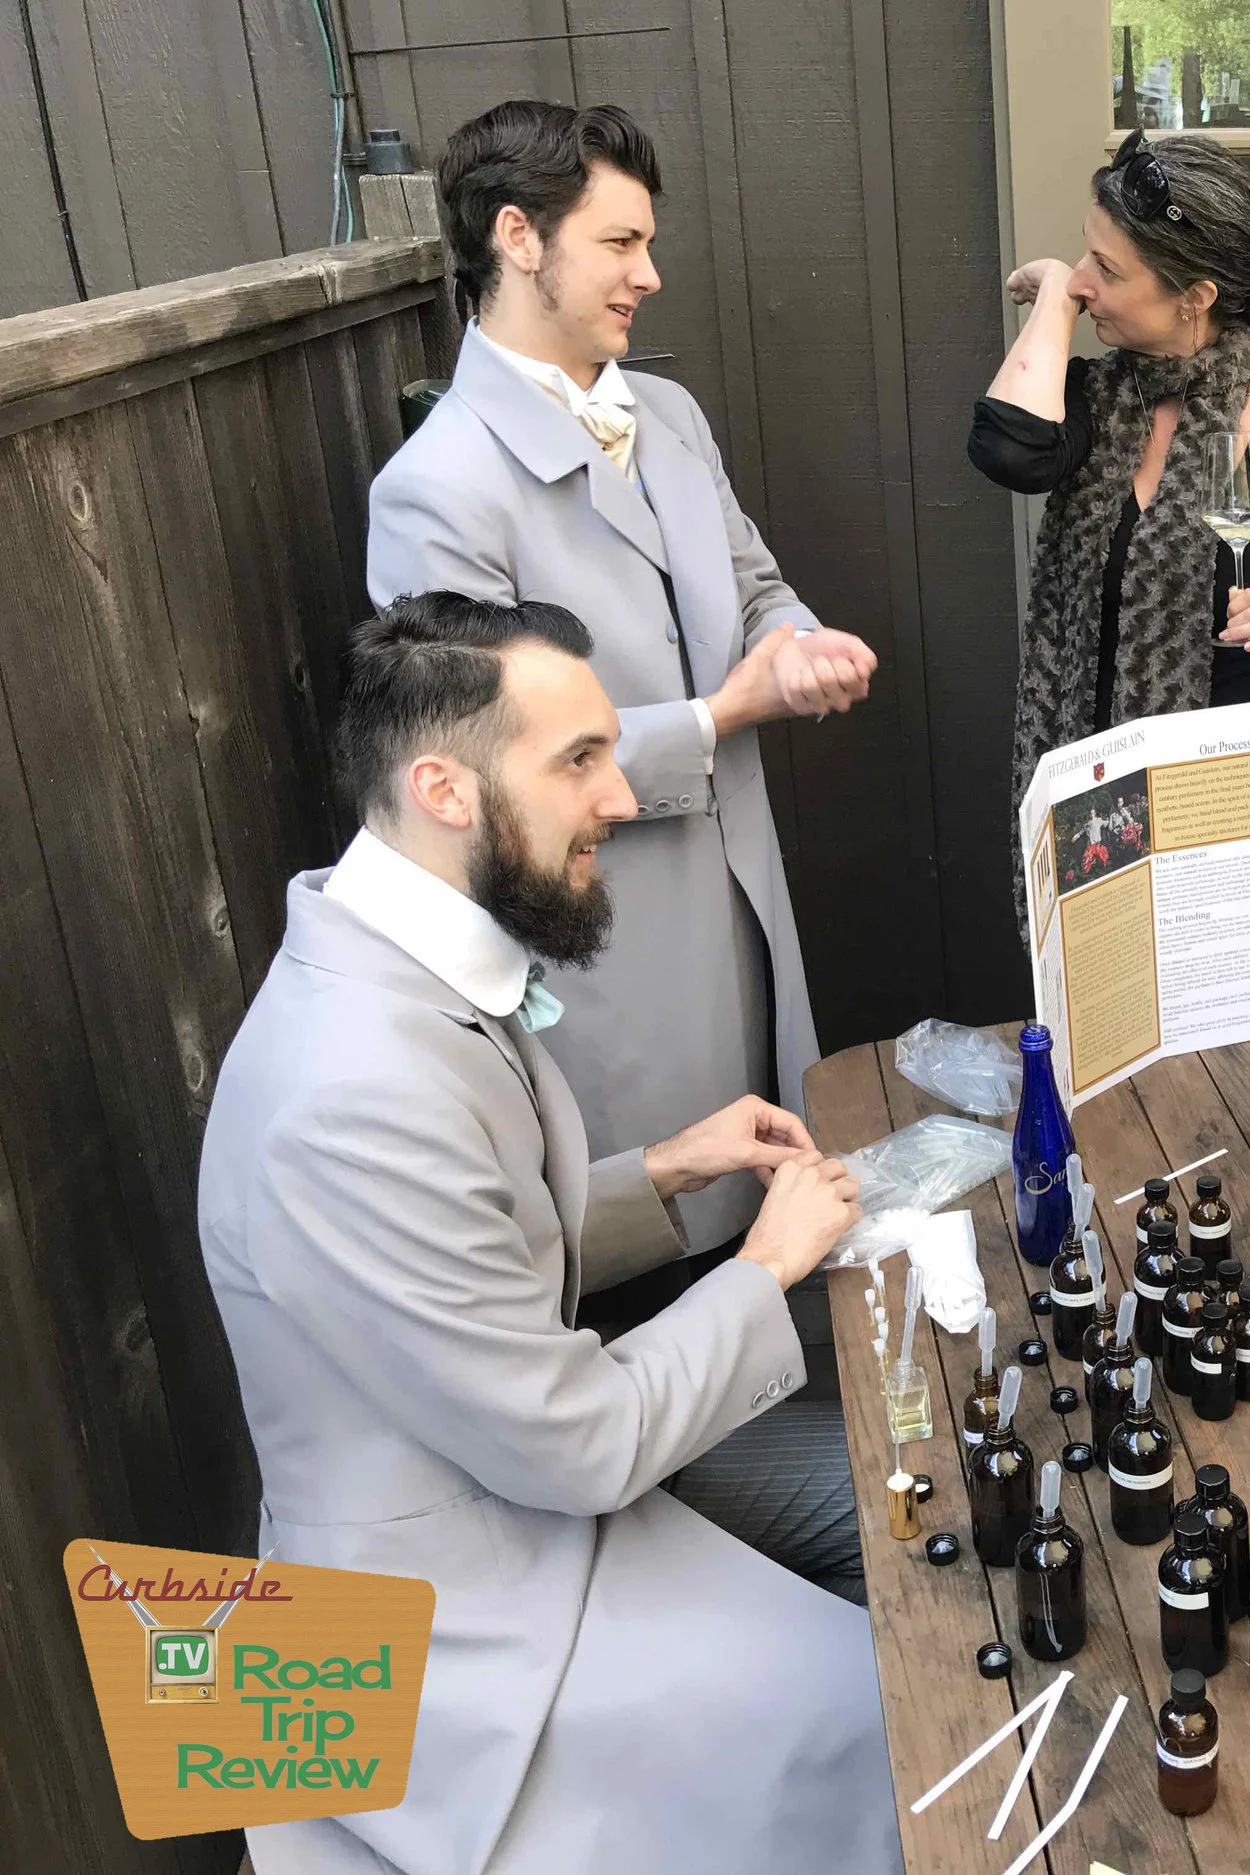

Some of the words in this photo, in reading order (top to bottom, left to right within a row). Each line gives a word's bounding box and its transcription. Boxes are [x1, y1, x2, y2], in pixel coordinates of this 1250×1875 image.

[1199, 743, 1216, 756] Our
[1155, 857, 1170, 865] The
[1172, 852, 1208, 863] Essences
[1159, 918, 1174, 927] The
[1175, 912, 1211, 924] Blending
